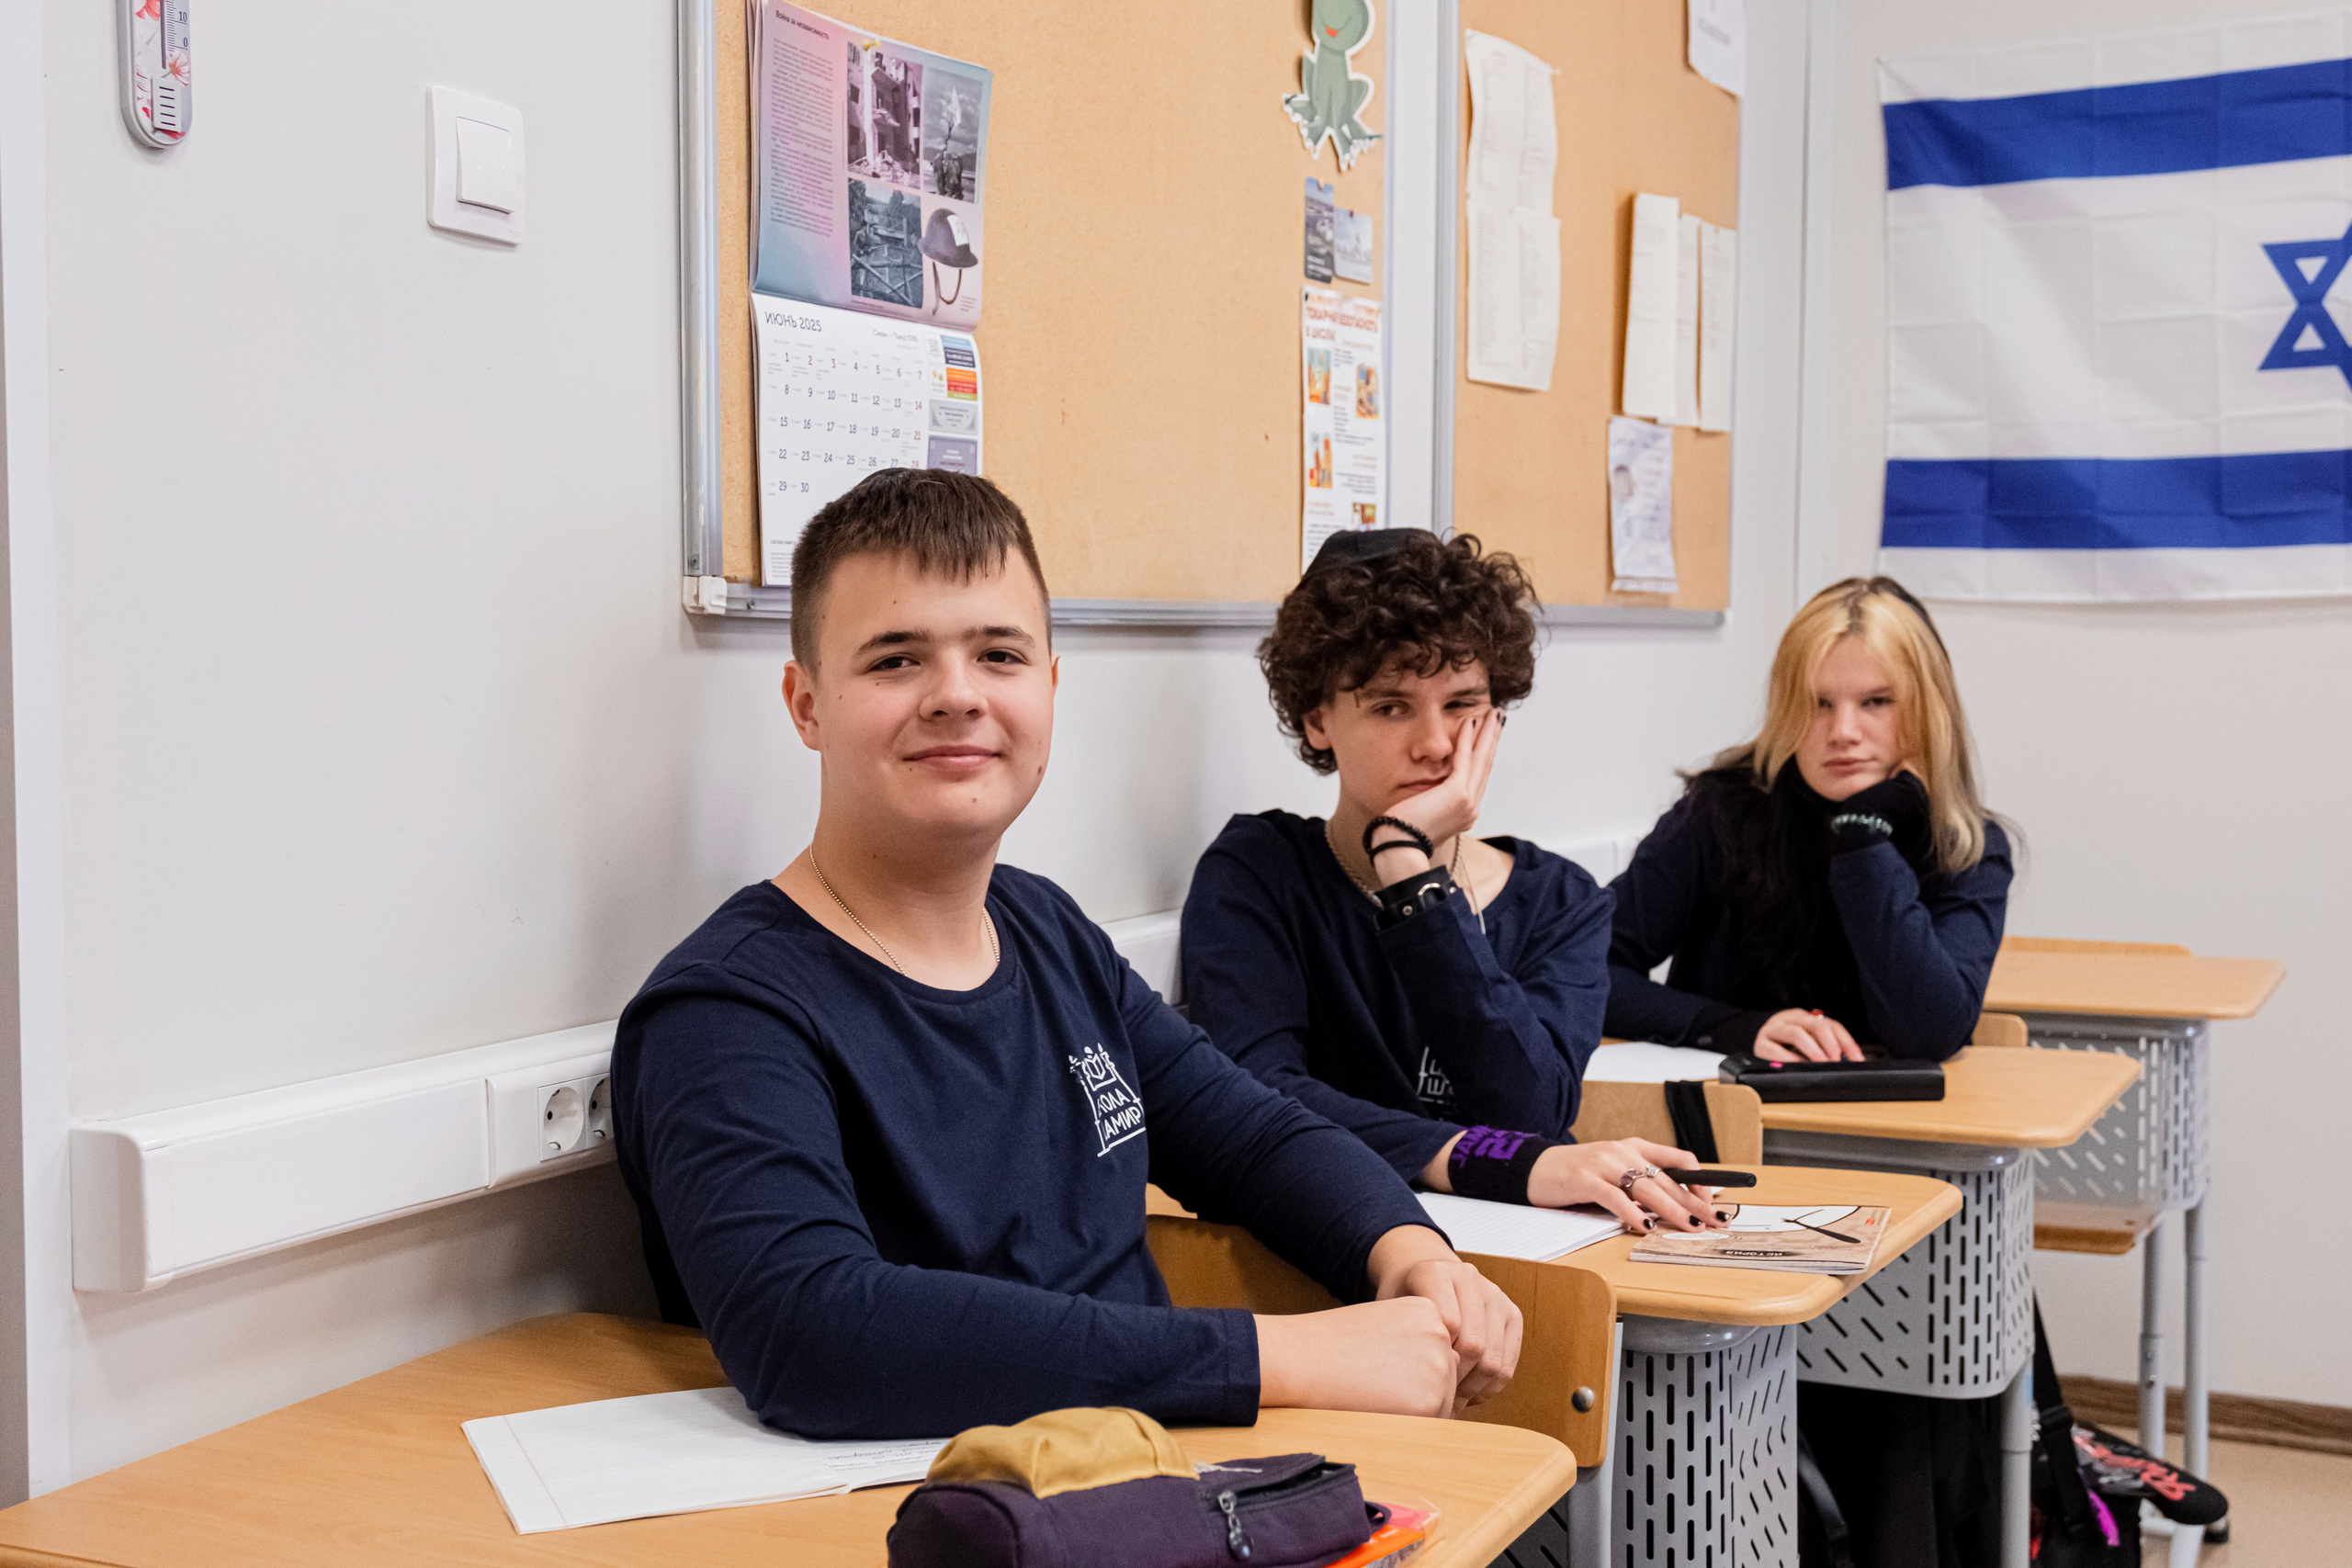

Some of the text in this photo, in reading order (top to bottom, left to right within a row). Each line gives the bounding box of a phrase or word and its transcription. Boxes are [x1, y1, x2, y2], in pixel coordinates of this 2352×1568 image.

[178, 11, 187, 22] 10
[183, 37, 188, 48] 0
[764, 310, 822, 333] ИЮНЬ 2025
[785, 352, 789, 363] 1
[808, 355, 813, 366] 2
[854, 361, 858, 371] 4
[897, 367, 901, 378] 6
[784, 384, 922, 411] 8 9 10 11 12 13 14
[780, 416, 921, 441] 15 16 17 18 19 20 21
[778, 448, 787, 459] 22
[801, 450, 809, 461] 23
[823, 452, 832, 463] 24
[846, 455, 855, 465] 25
[868, 457, 876, 467] 26
[890, 458, 899, 468] 27
[778, 480, 809, 493] 29 30
